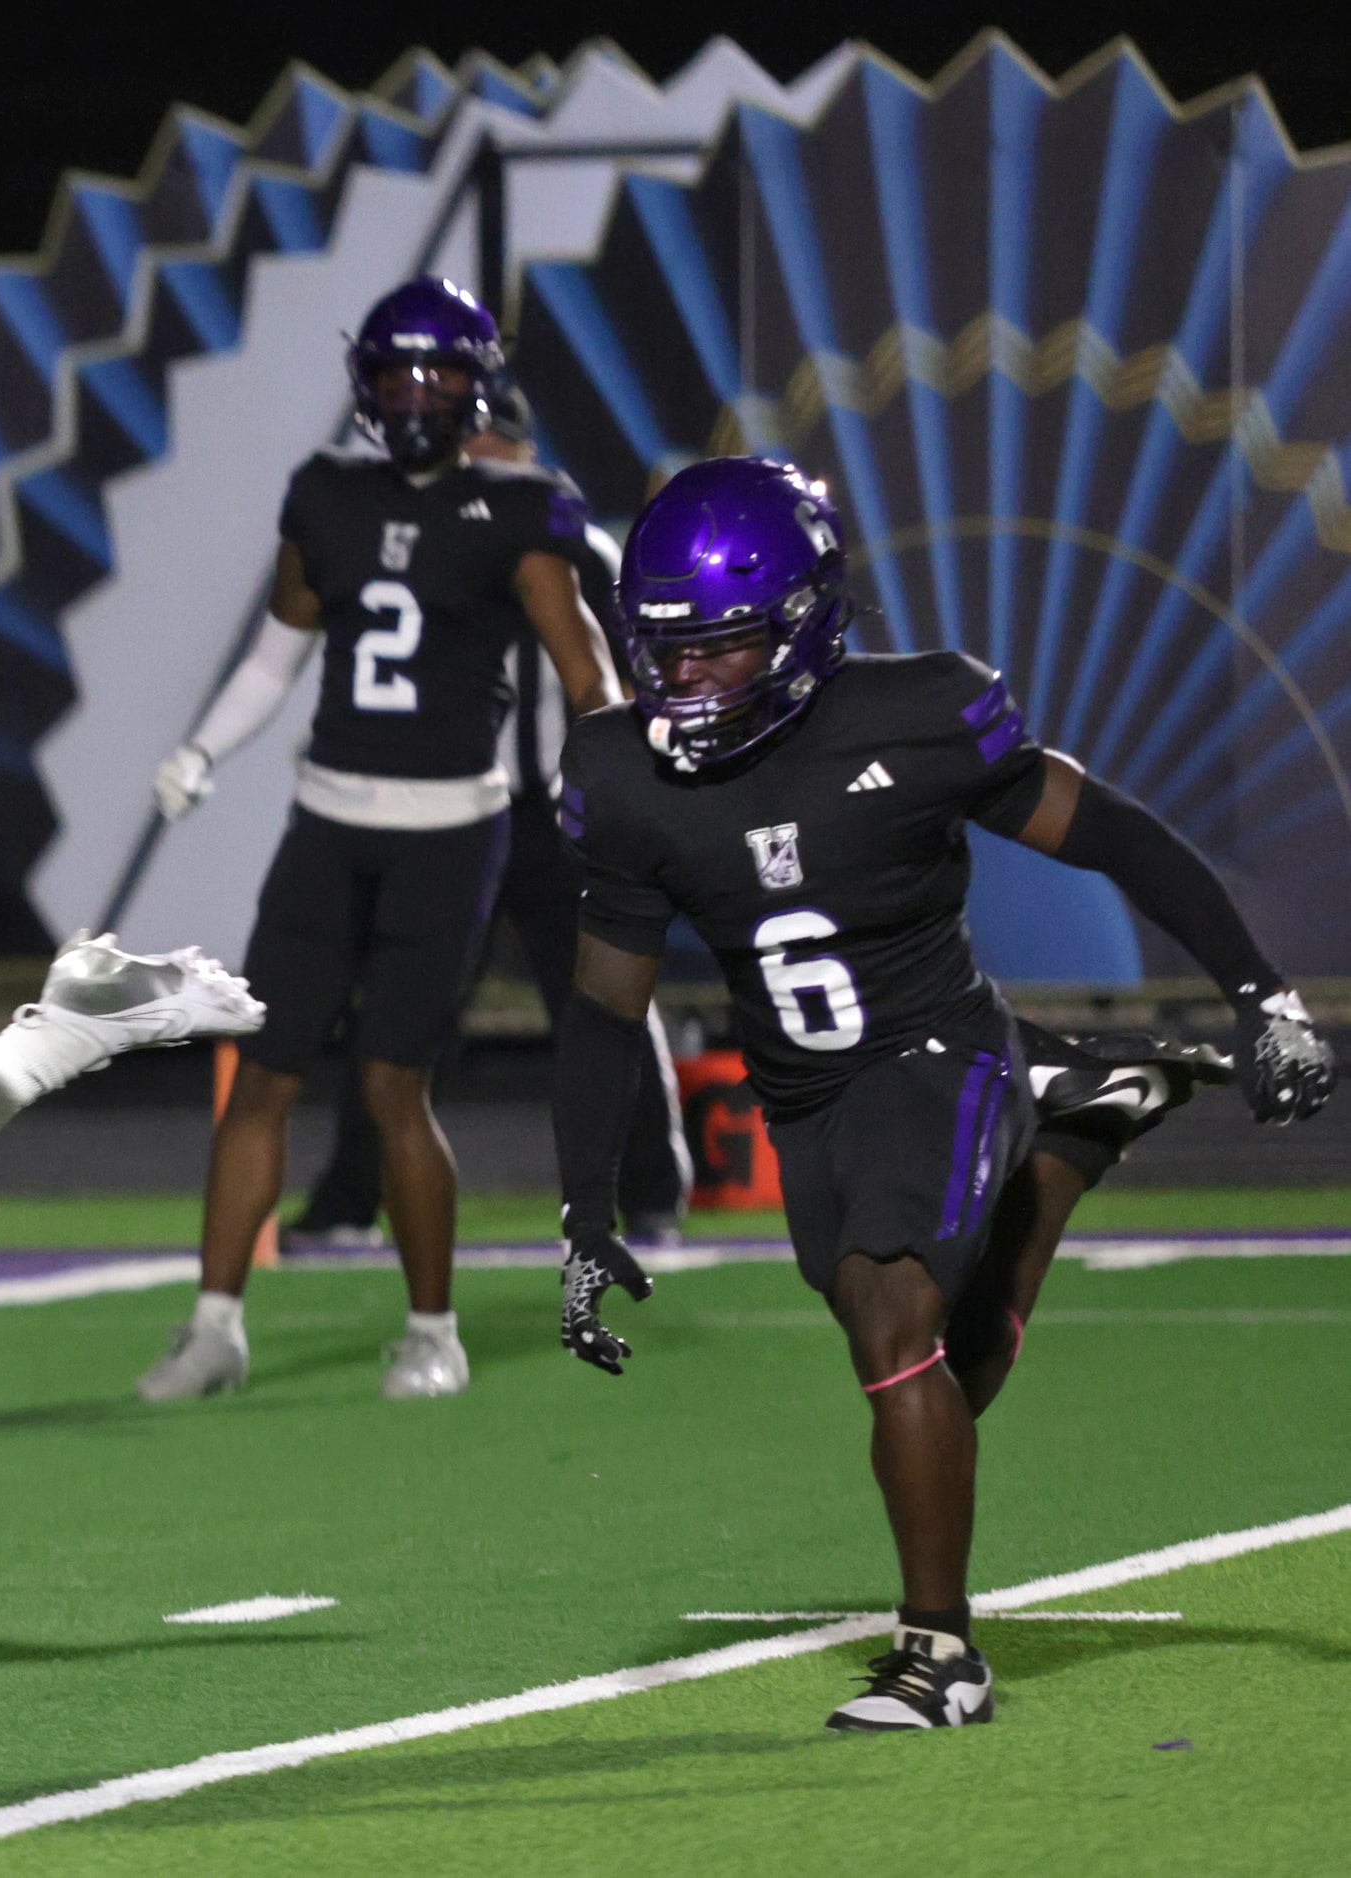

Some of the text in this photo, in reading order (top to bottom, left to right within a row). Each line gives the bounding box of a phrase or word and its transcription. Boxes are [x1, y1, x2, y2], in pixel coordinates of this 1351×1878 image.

[352, 580, 424, 712] 2
[752, 904, 867, 1053] 6
[685, 1080, 753, 1188] G
